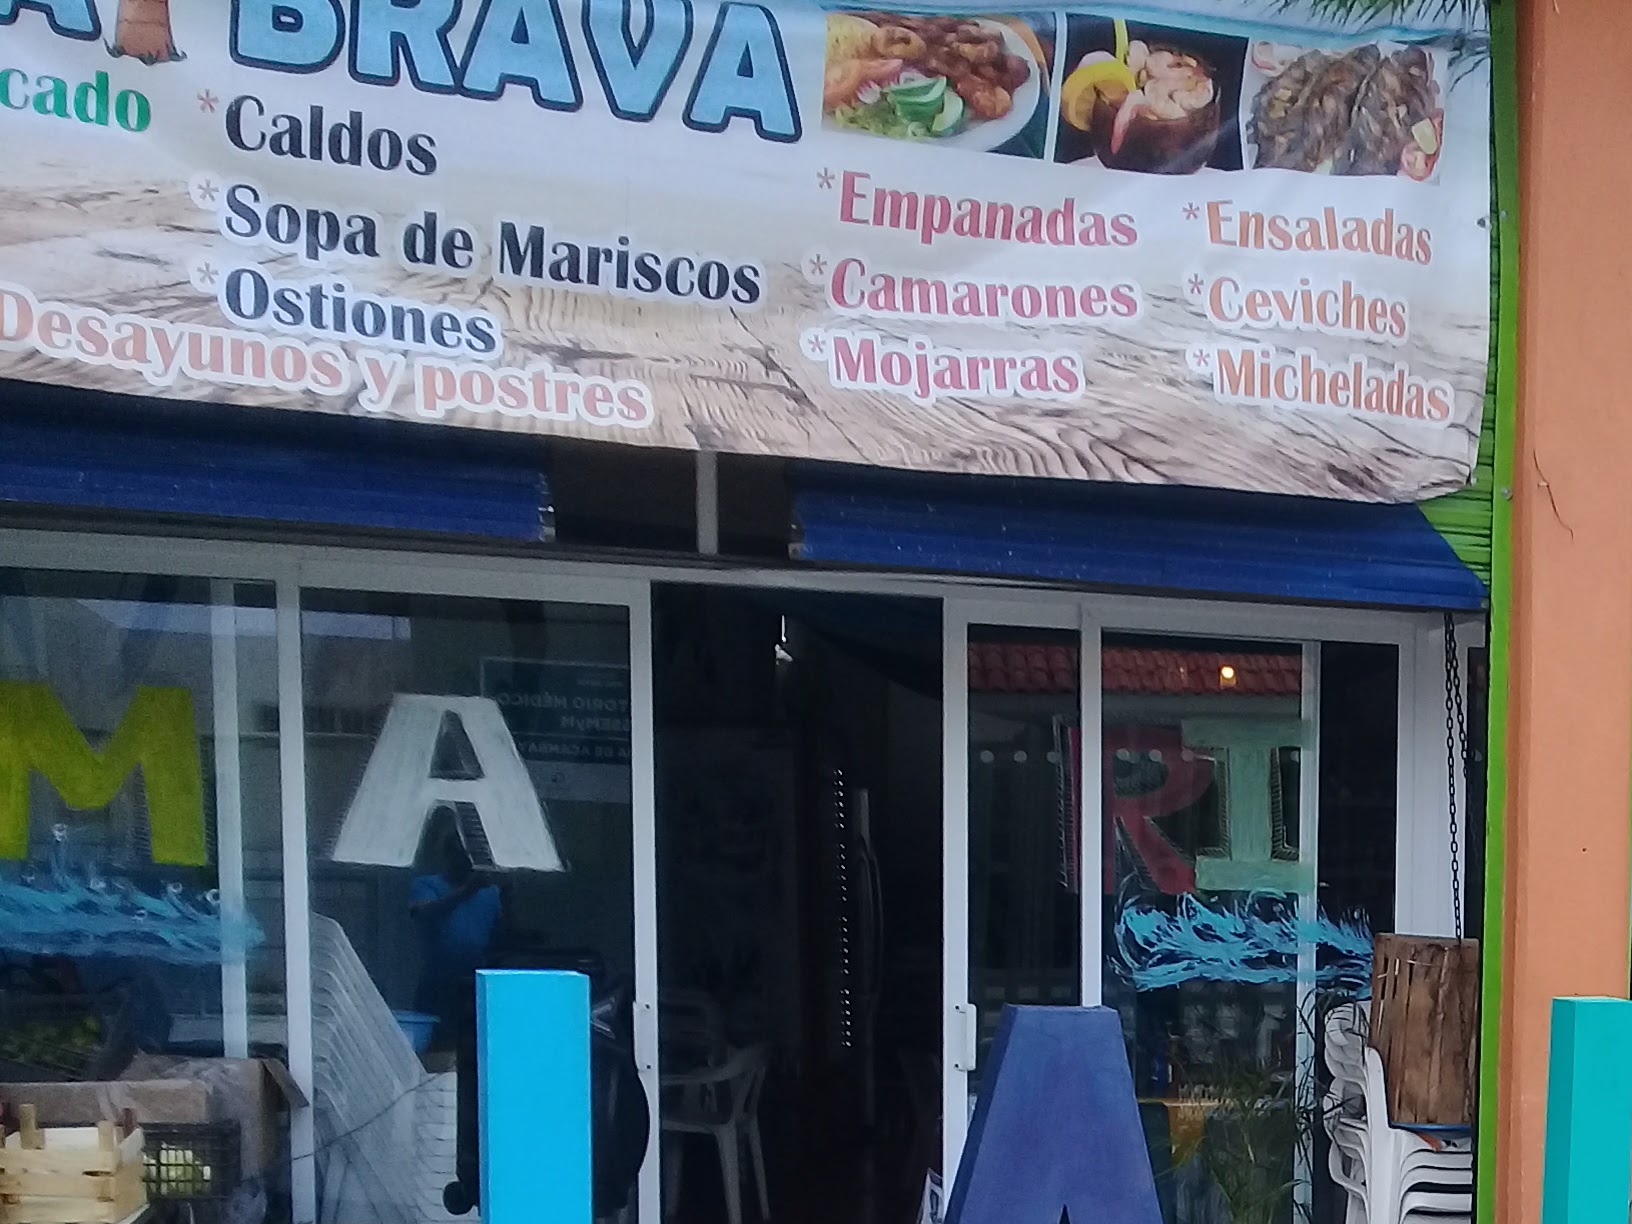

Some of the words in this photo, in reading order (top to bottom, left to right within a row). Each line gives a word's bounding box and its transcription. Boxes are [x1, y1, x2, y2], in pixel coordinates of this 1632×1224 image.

[229, 0, 801, 143] BRAVA
[225, 94, 438, 175] Caldos
[225, 184, 380, 260] Sopa
[403, 211, 473, 269] de
[499, 220, 761, 304] Mariscos
[840, 172, 1139, 247] Empanadas
[1207, 200, 1433, 266] Ensaladas
[225, 268, 498, 353] Ostiones
[832, 259, 1139, 319] Camarones
[1209, 278, 1408, 339] Ceviches
[364, 352, 398, 403] y
[420, 364, 647, 422] postres
[832, 337, 1080, 398] Mojarras
[1213, 350, 1450, 423] Micheladas
